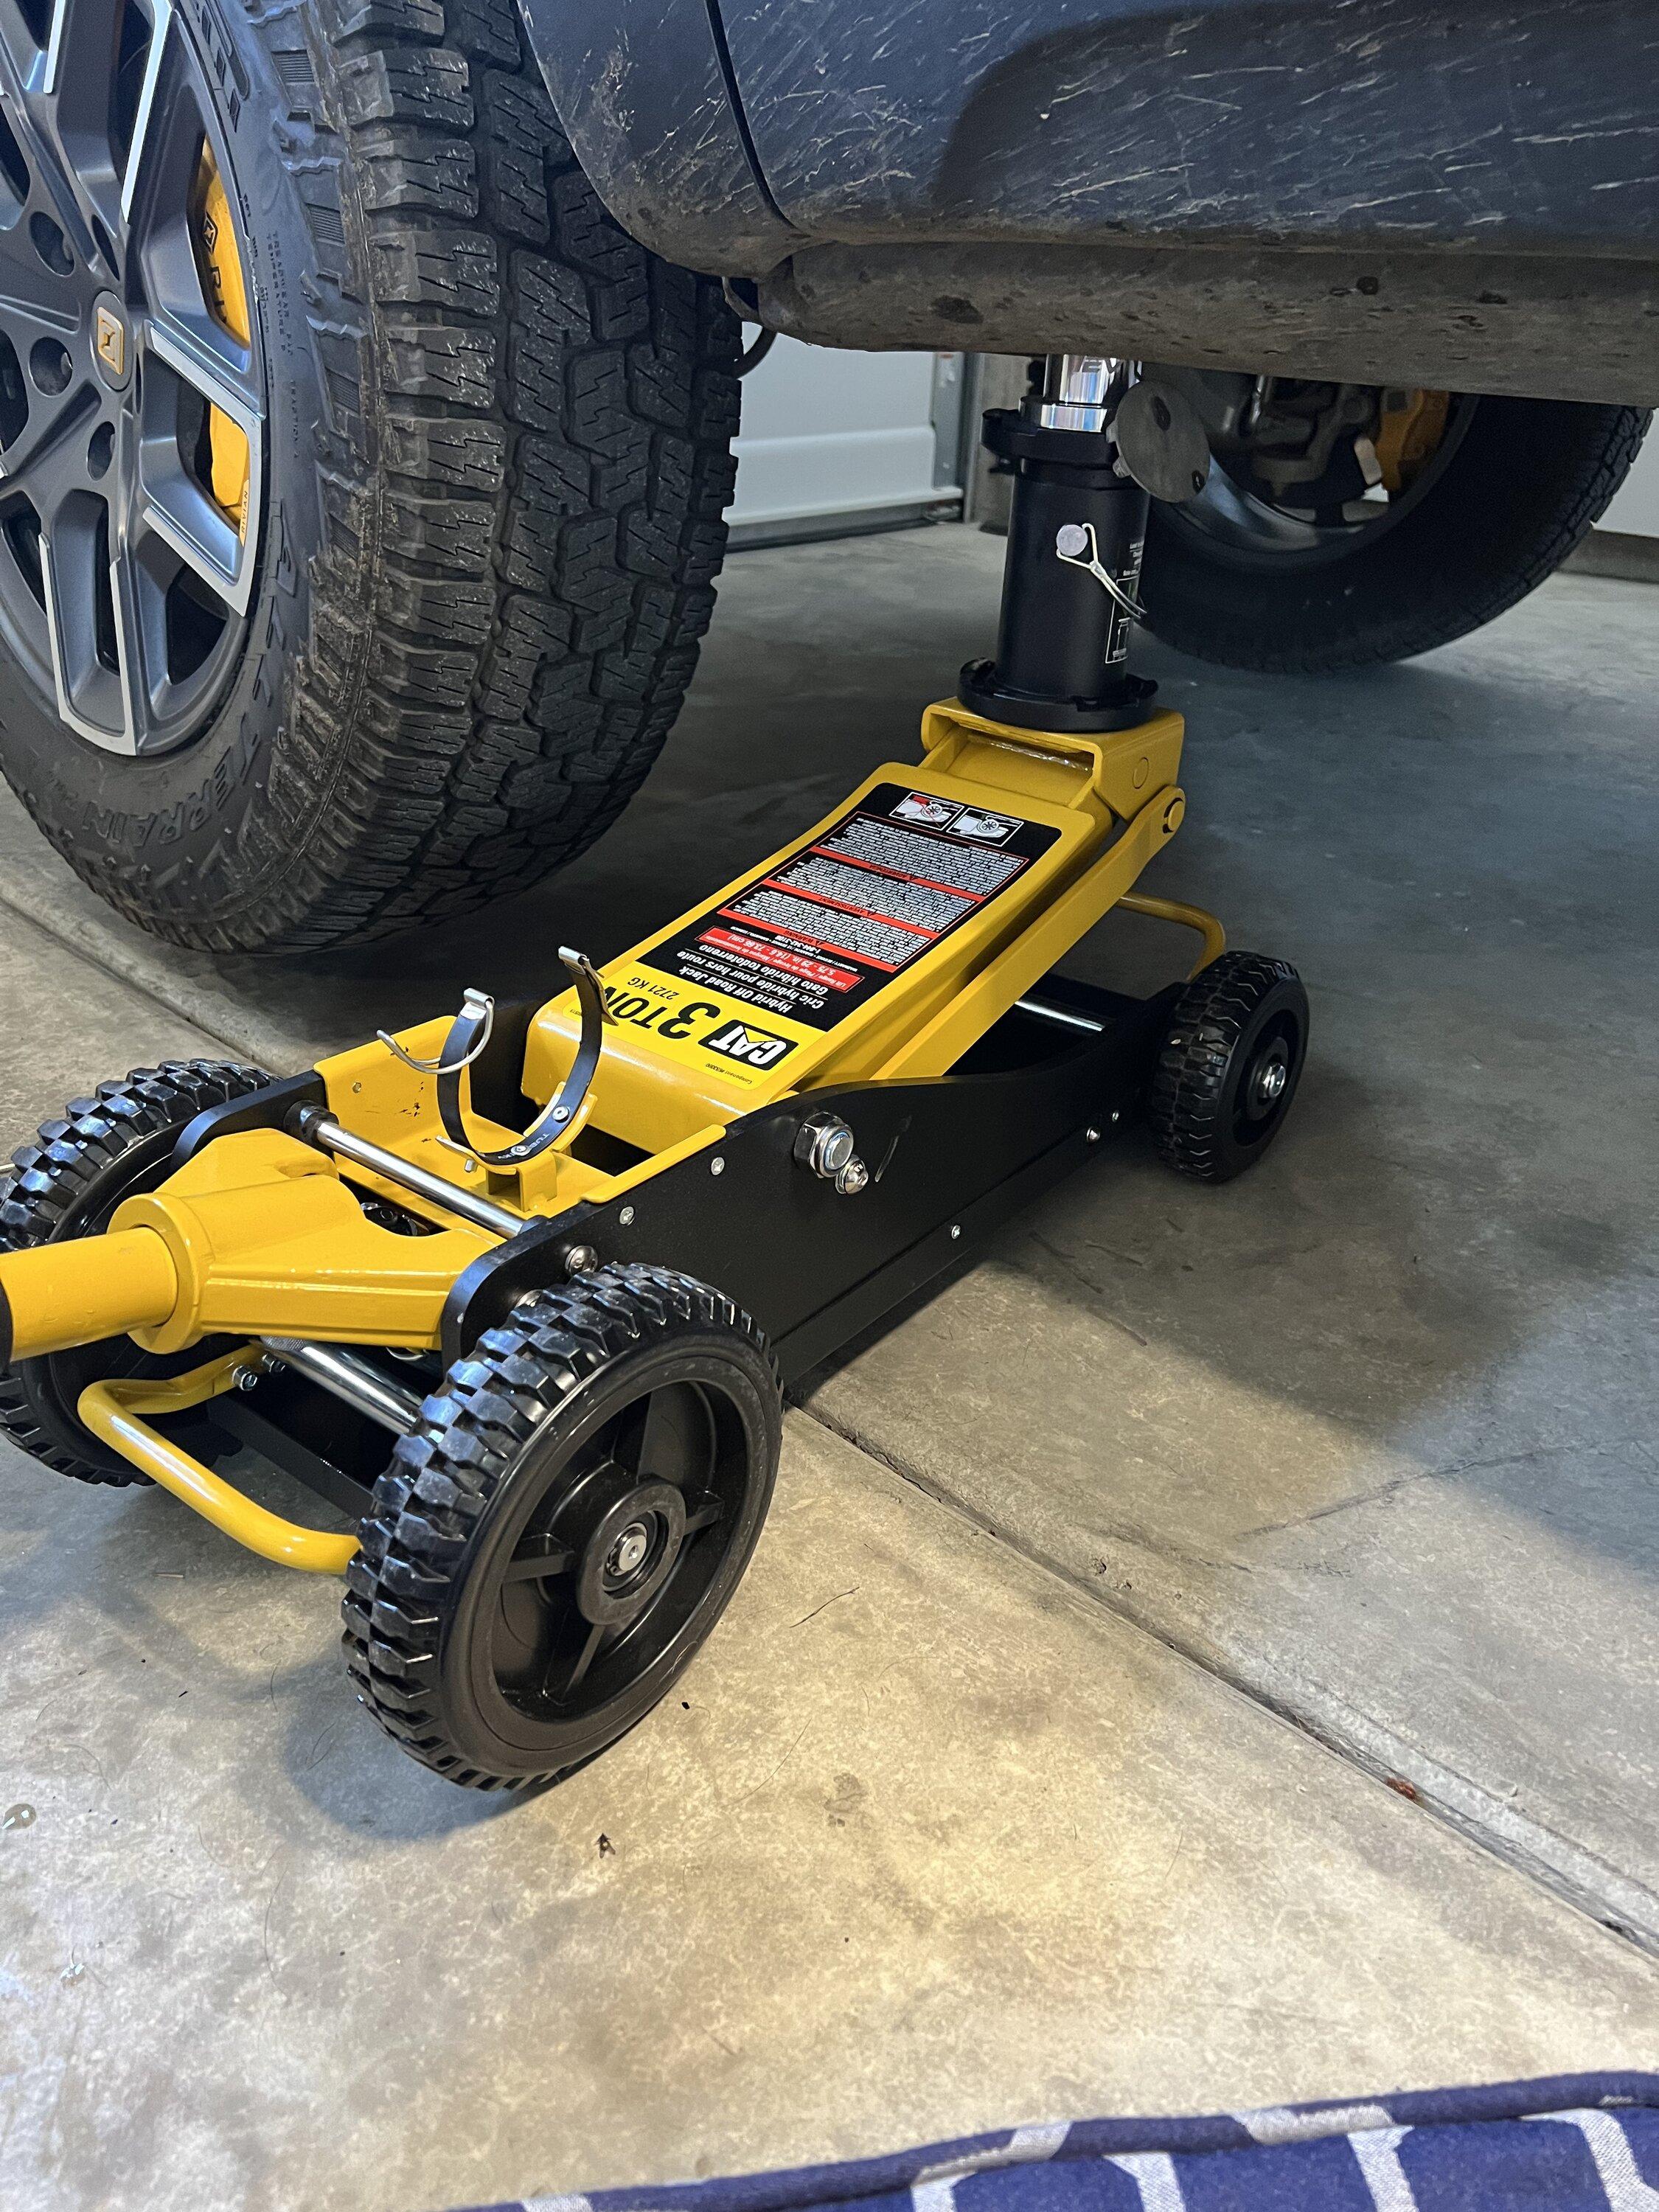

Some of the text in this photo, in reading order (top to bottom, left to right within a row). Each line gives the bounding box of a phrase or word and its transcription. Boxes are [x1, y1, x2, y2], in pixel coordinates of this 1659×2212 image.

[82, 712, 260, 848] TERRAIN
[782, 930, 815, 943] WARNING
[677, 951, 824, 1008] Cric hybride pour hors route
[699, 945, 827, 995] Gato híbrido todoterreno
[798, 959, 815, 967] 29
[815, 965, 837, 976] 5.75
[627, 977, 679, 999] 2721 KG
[678, 966, 792, 1012] Hybrid Off Road Jack
[658, 1002, 720, 1038] 3
[709, 1025, 787, 1065] CAT
[725, 1071, 751, 1083] Component
